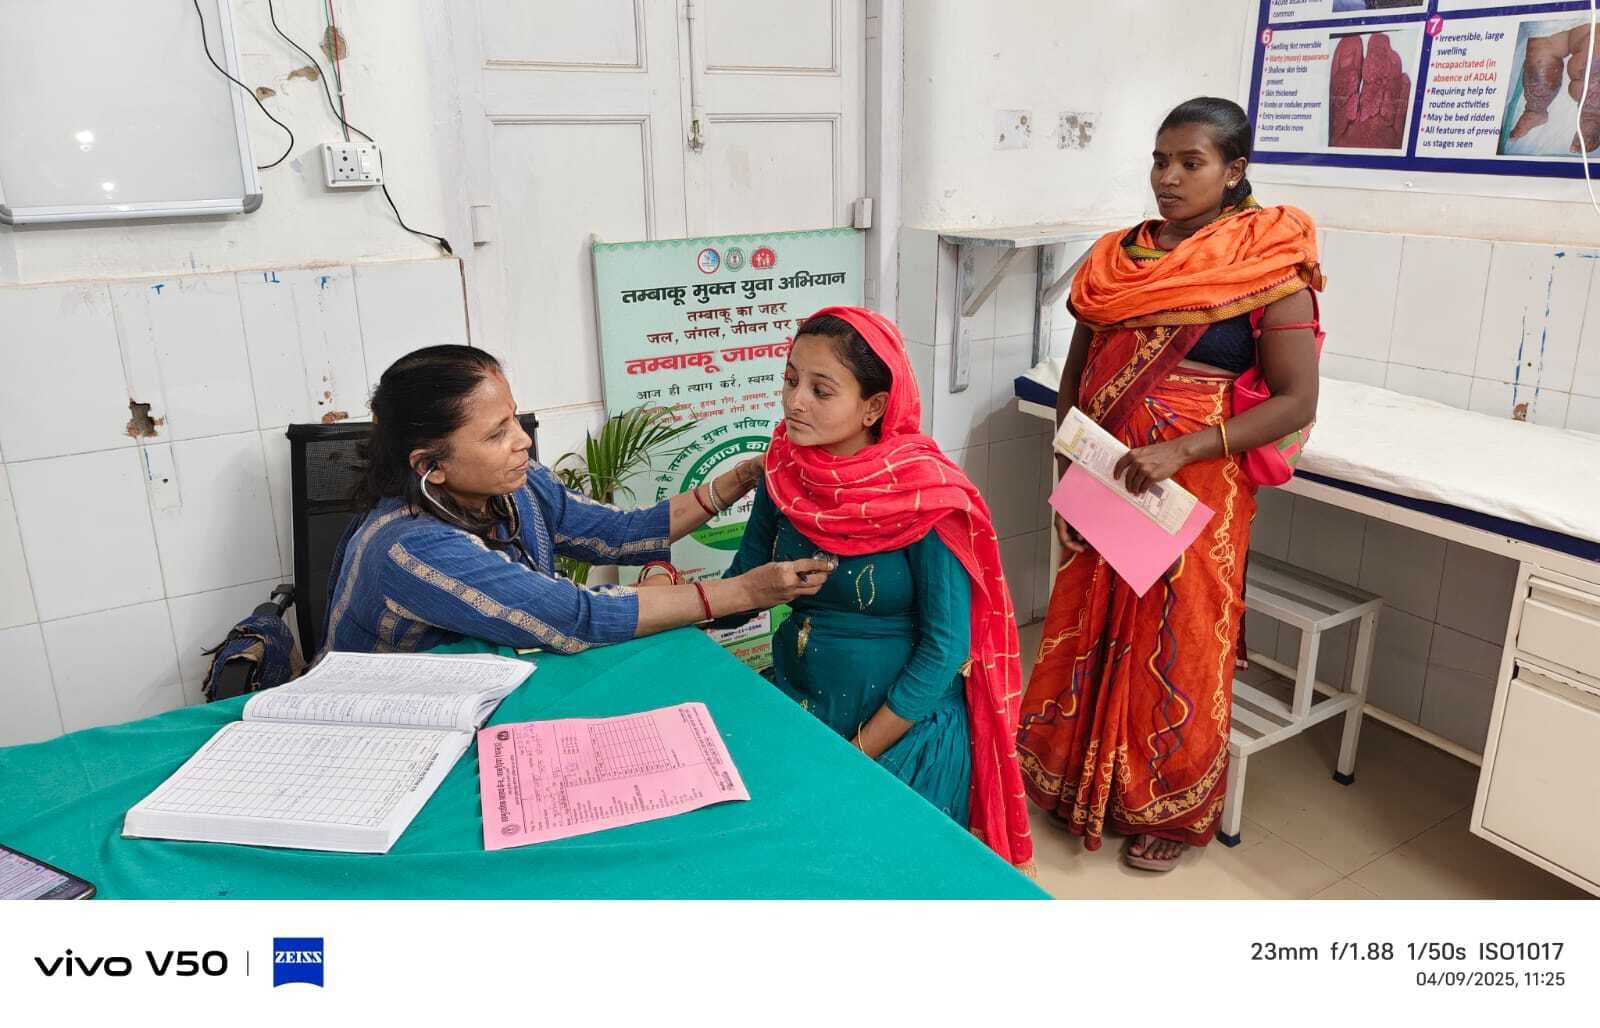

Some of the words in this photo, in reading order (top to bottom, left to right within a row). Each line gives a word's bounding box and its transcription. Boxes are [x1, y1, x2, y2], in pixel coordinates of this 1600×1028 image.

[1262, 29, 1270, 44] 6
[1485, 31, 1504, 40] large
[1438, 46, 1467, 56] swelling
[1435, 60, 1485, 70] Incapacitated
[1433, 74, 1462, 82] absence
[1464, 73, 1472, 81] of
[1473, 72, 1497, 82] ADLA)
[1431, 87, 1465, 97] Requiring
[1467, 86, 1483, 96] help
[1485, 86, 1496, 94] for
[1429, 101, 1455, 109] routine
[1456, 101, 1489, 109] activities
[1427, 113, 1443, 121] May
[1470, 113, 1495, 121] ridden
[1425, 126, 1434, 134] All
[1436, 126, 1464, 135] features
[1467, 126, 1475, 134] of
[1433, 140, 1454, 148] stages
[1456, 140, 1473, 148] seen
[621, 285, 687, 306] तम्बाकू
[692, 281, 736, 303] मुक्त
[740, 278, 773, 300] युवा
[777, 270, 847, 289] अभियान
[687, 307, 731, 323] तम्बाकू
[736, 305, 752, 317] का
[758, 302, 788, 315] जहर
[647, 331, 680, 345] जल,
[684, 325, 726, 341] जंगल,
[730, 320, 770, 336] जीवन
[772, 318, 792, 331] पर
[625, 350, 721, 376] तम्बाकू
[636, 389, 661, 401] आज
[668, 383, 681, 397] ही
[687, 382, 713, 393] त्याग
[701, 425, 730, 444] मुक्त
[734, 416, 771, 431] भविष्य
[696, 443, 741, 475] समाज
